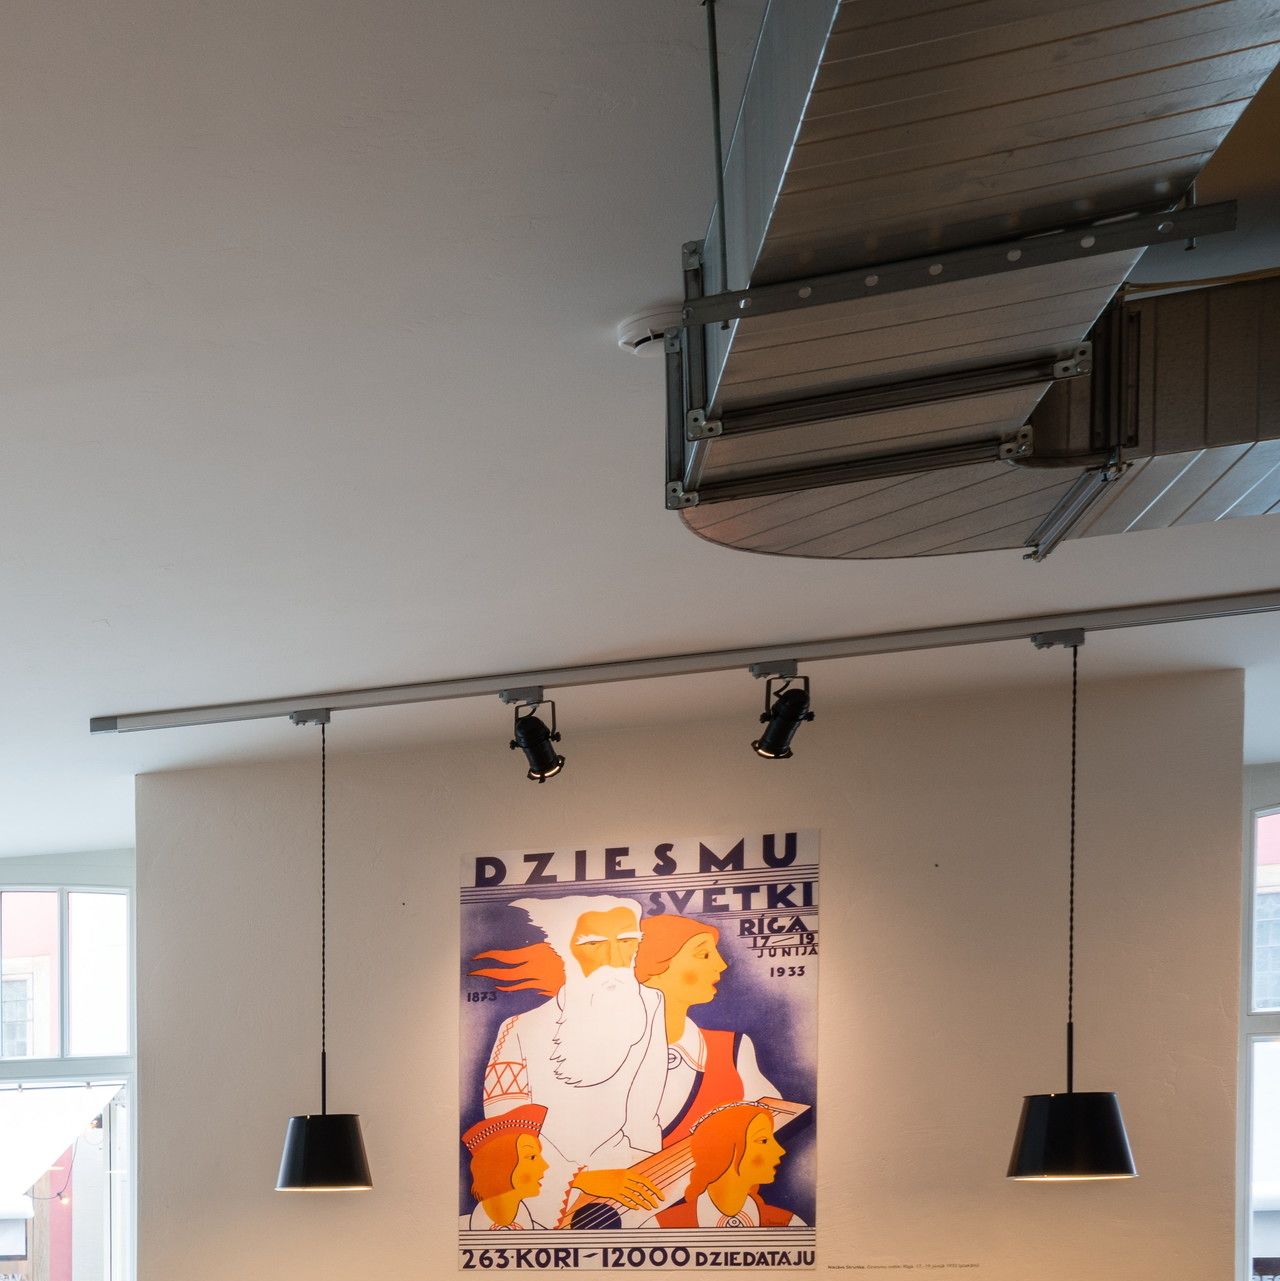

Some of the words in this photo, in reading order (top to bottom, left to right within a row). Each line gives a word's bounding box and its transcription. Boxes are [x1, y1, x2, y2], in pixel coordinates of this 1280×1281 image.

[475, 832, 798, 887] DZIESMU
[752, 935, 771, 948] 17
[799, 932, 815, 945] 19
[770, 966, 805, 977] 1933
[467, 991, 497, 1002] 1873
[602, 1246, 691, 1268] 12000
